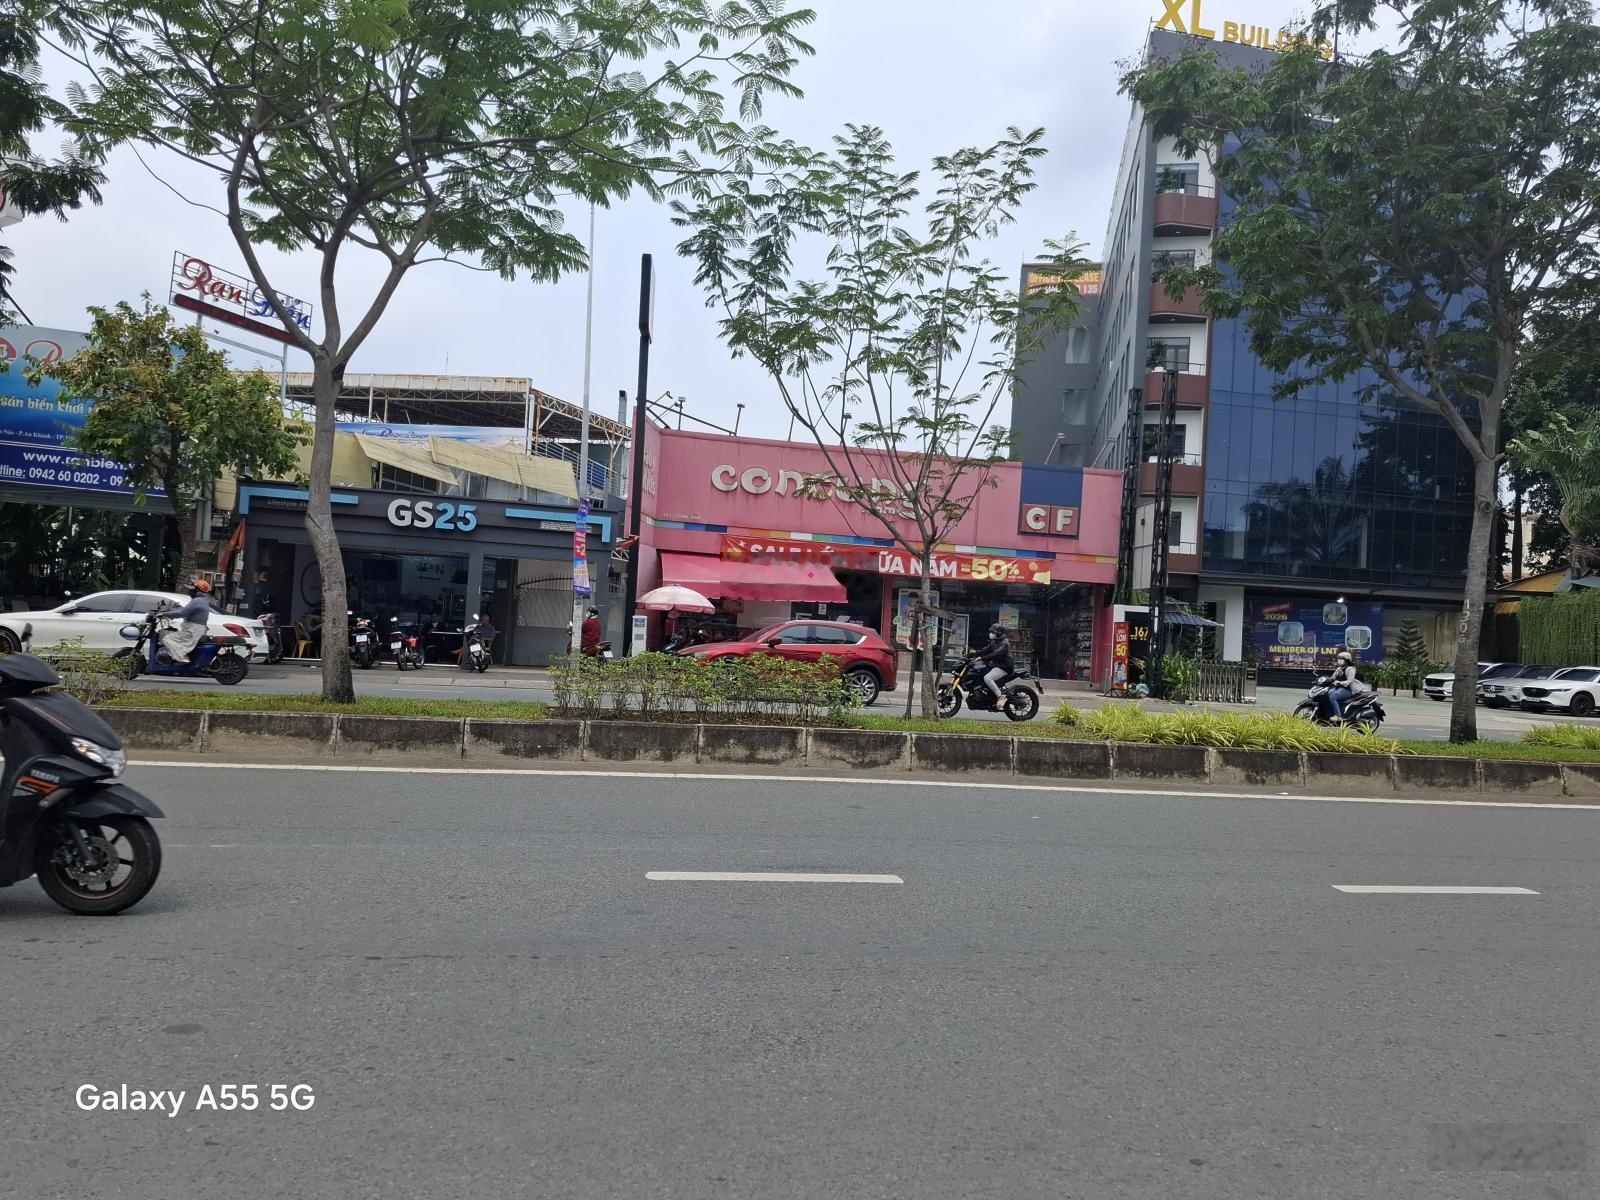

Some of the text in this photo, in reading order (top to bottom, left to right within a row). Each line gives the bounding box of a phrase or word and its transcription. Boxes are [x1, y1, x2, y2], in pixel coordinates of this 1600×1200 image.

[1155, 0, 1216, 40] XL
[29, 467, 55, 481] 0942
[58, 470, 71, 483] 60
[74, 472, 99, 485] 0202
[387, 498, 477, 532] GS25
[1134, 626, 1149, 637] 167
[1269, 645, 1305, 654] MEMBER
[1321, 647, 1338, 655] LNT
